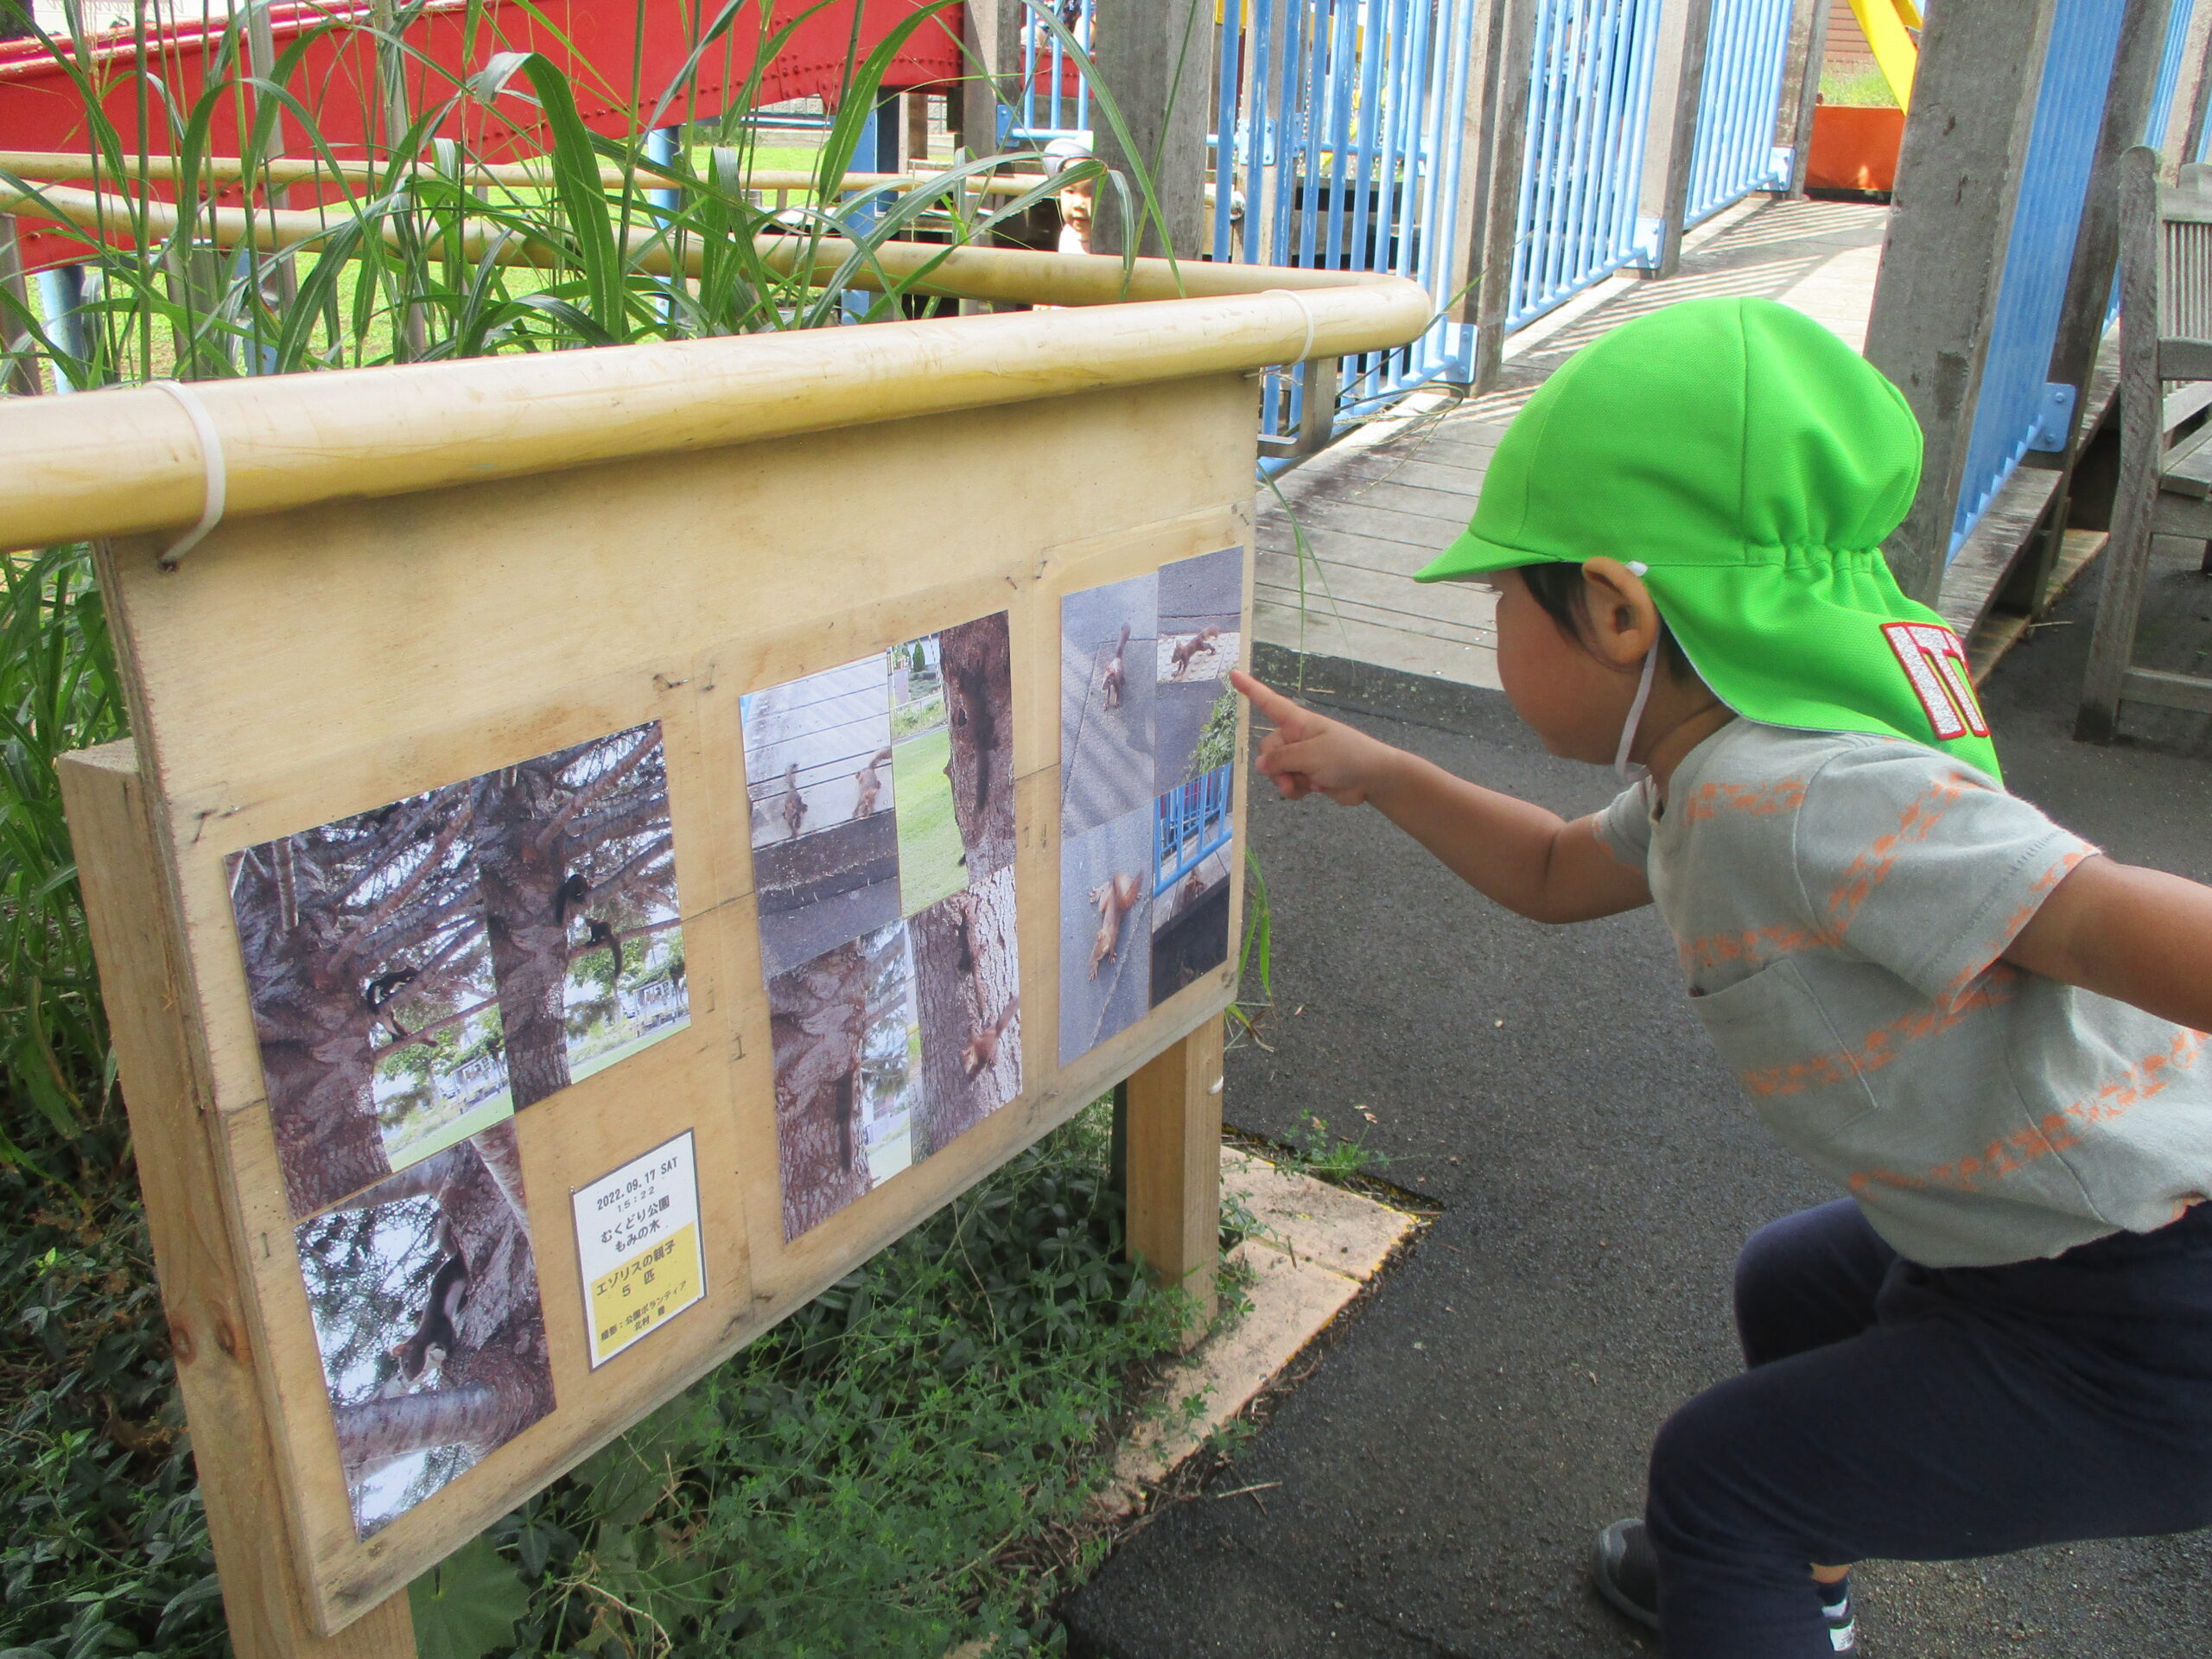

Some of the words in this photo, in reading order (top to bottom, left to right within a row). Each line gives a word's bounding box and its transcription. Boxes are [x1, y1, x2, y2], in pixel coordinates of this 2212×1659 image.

[660, 1156, 677, 1175] SAT
[601, 1194, 670, 1243] むくどり公園
[615, 1218, 661, 1253] もみの木
[596, 1239, 676, 1296] エゾリスの親子
